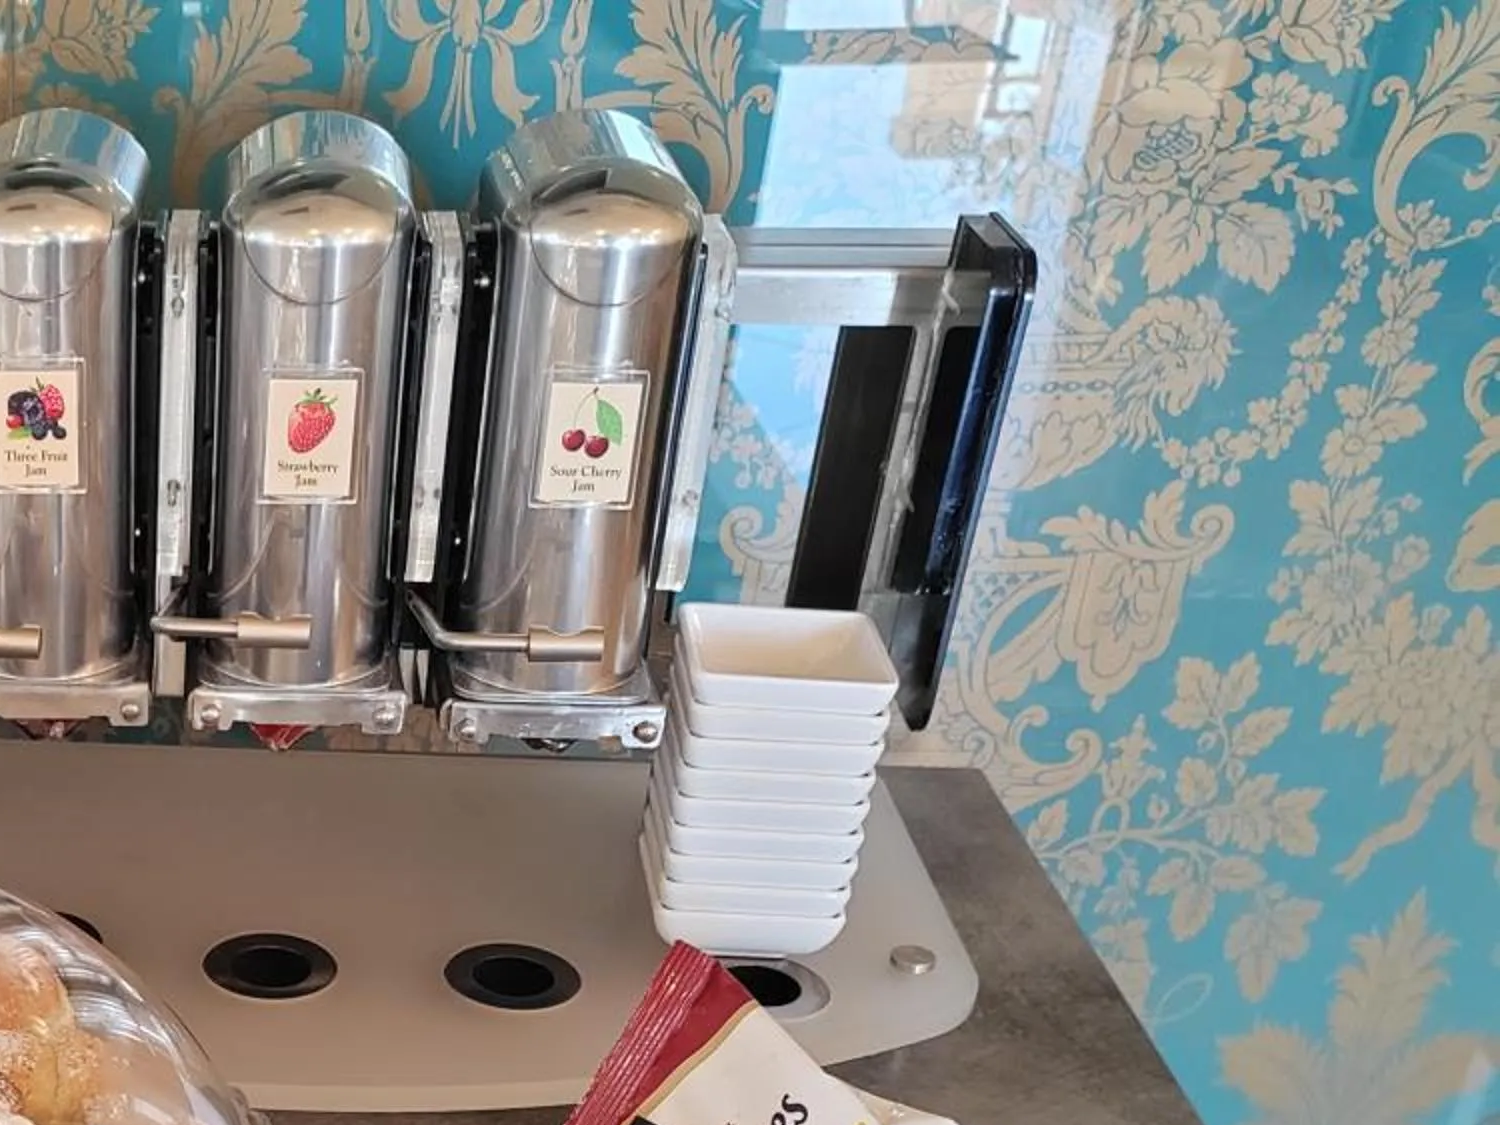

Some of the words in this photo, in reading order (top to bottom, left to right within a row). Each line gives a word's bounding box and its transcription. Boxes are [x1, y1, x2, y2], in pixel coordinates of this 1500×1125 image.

[3, 449, 37, 463] Three
[41, 449, 68, 463] Fruit
[25, 463, 47, 477] Jam
[277, 459, 339, 474] Strawberry
[549, 464, 578, 477] Sour
[581, 464, 622, 480] Cherry
[294, 473, 318, 488] Jam
[571, 479, 596, 493] Jam
